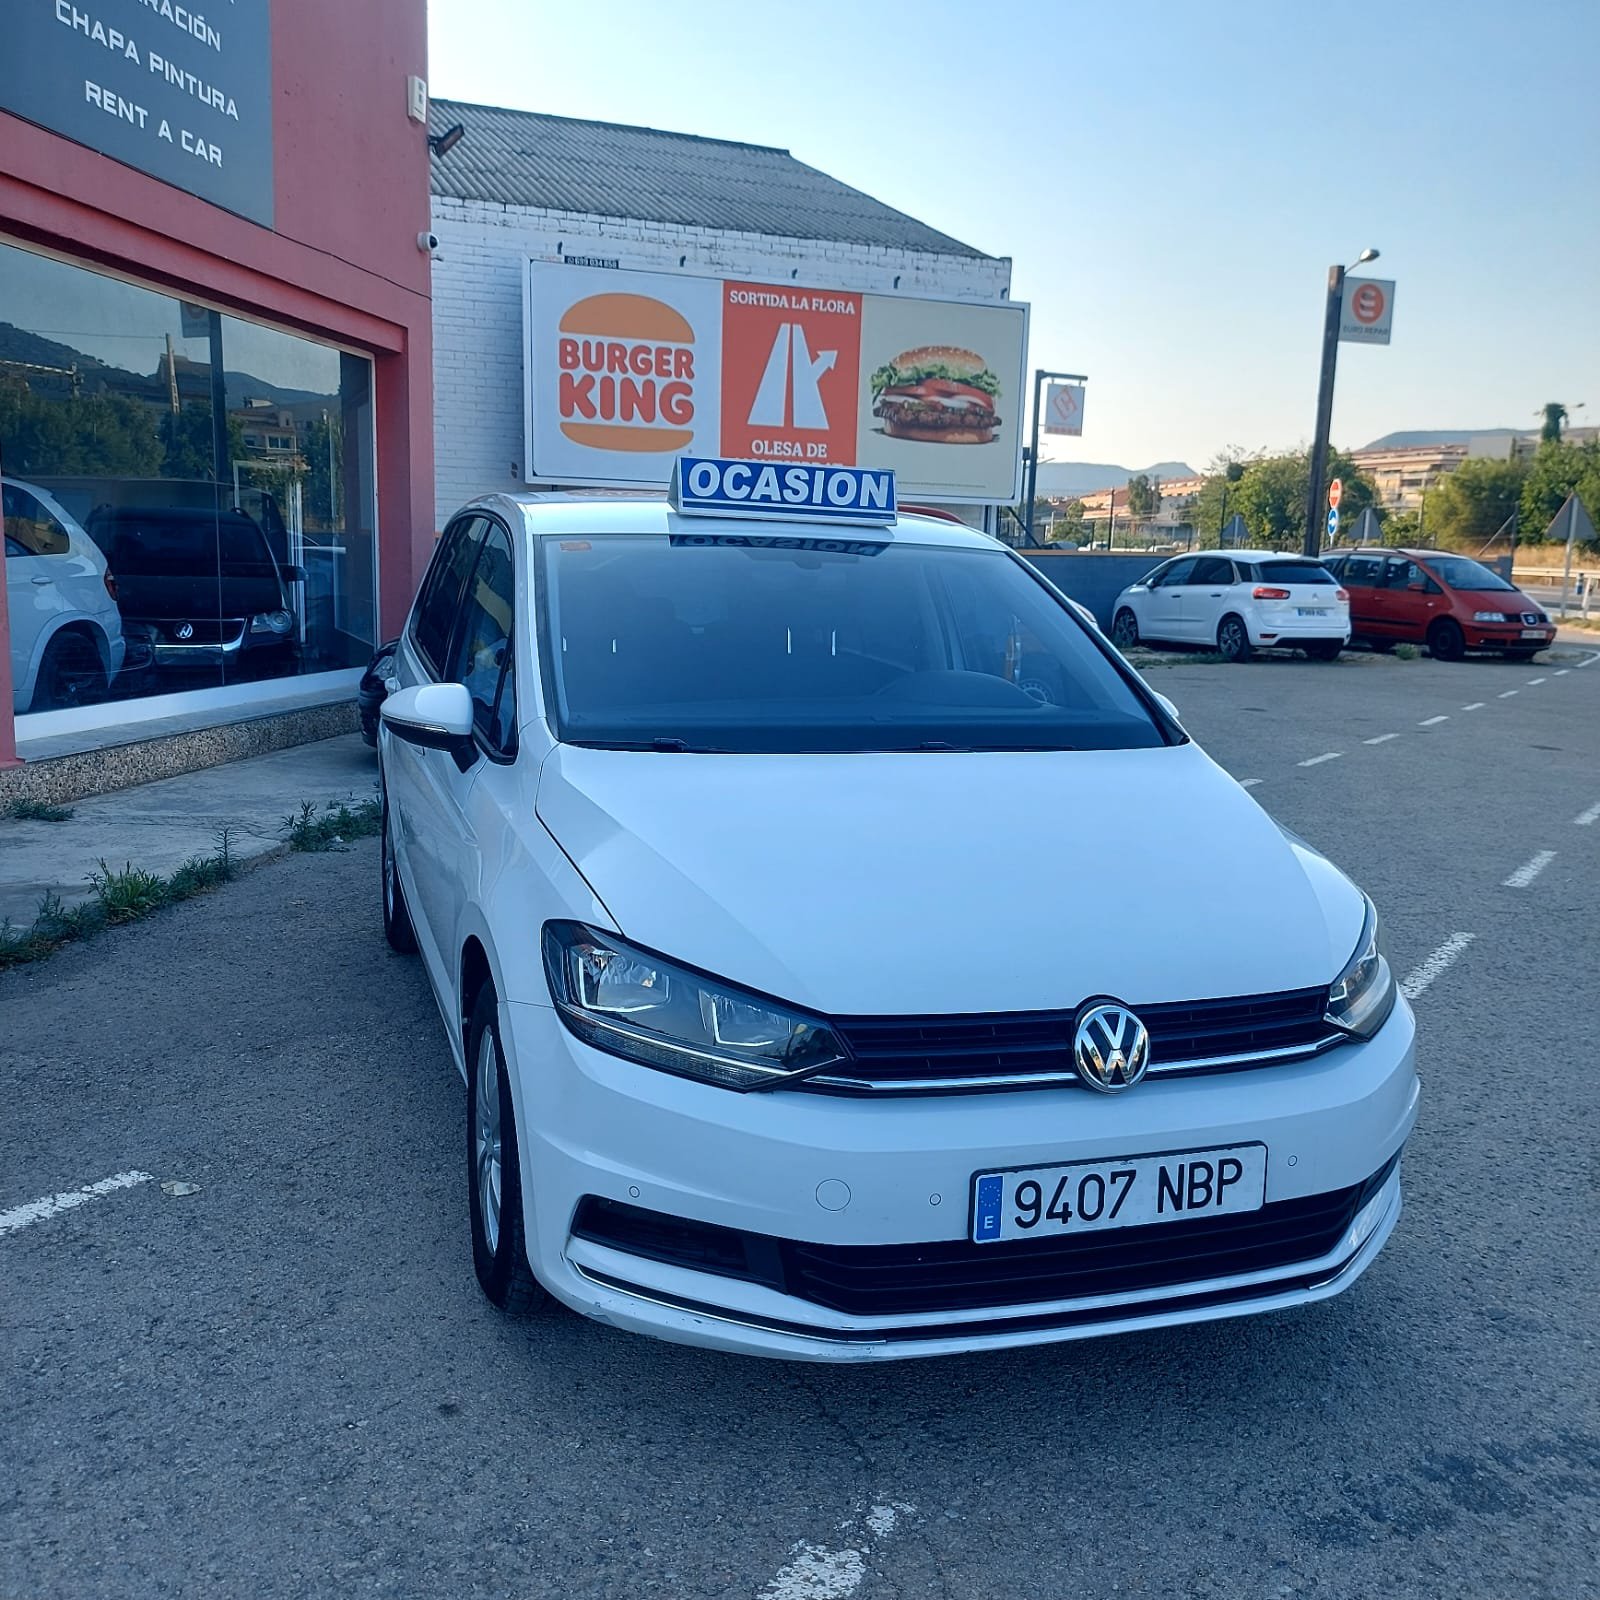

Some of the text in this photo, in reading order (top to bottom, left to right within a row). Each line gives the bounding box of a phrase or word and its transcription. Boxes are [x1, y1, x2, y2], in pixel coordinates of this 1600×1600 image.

[55, 0, 239, 121] CHAPA PINTURA
[85, 80, 223, 168] RENT A CAR
[730, 290, 855, 314] SORTIDA LA FLORA
[559, 338, 695, 380] BURGER
[559, 372, 695, 426] KING
[751, 440, 828, 458] OLESA DE
[688, 462, 889, 508] OCASION
[983, 1158, 1243, 1229] E 9407 NBP
